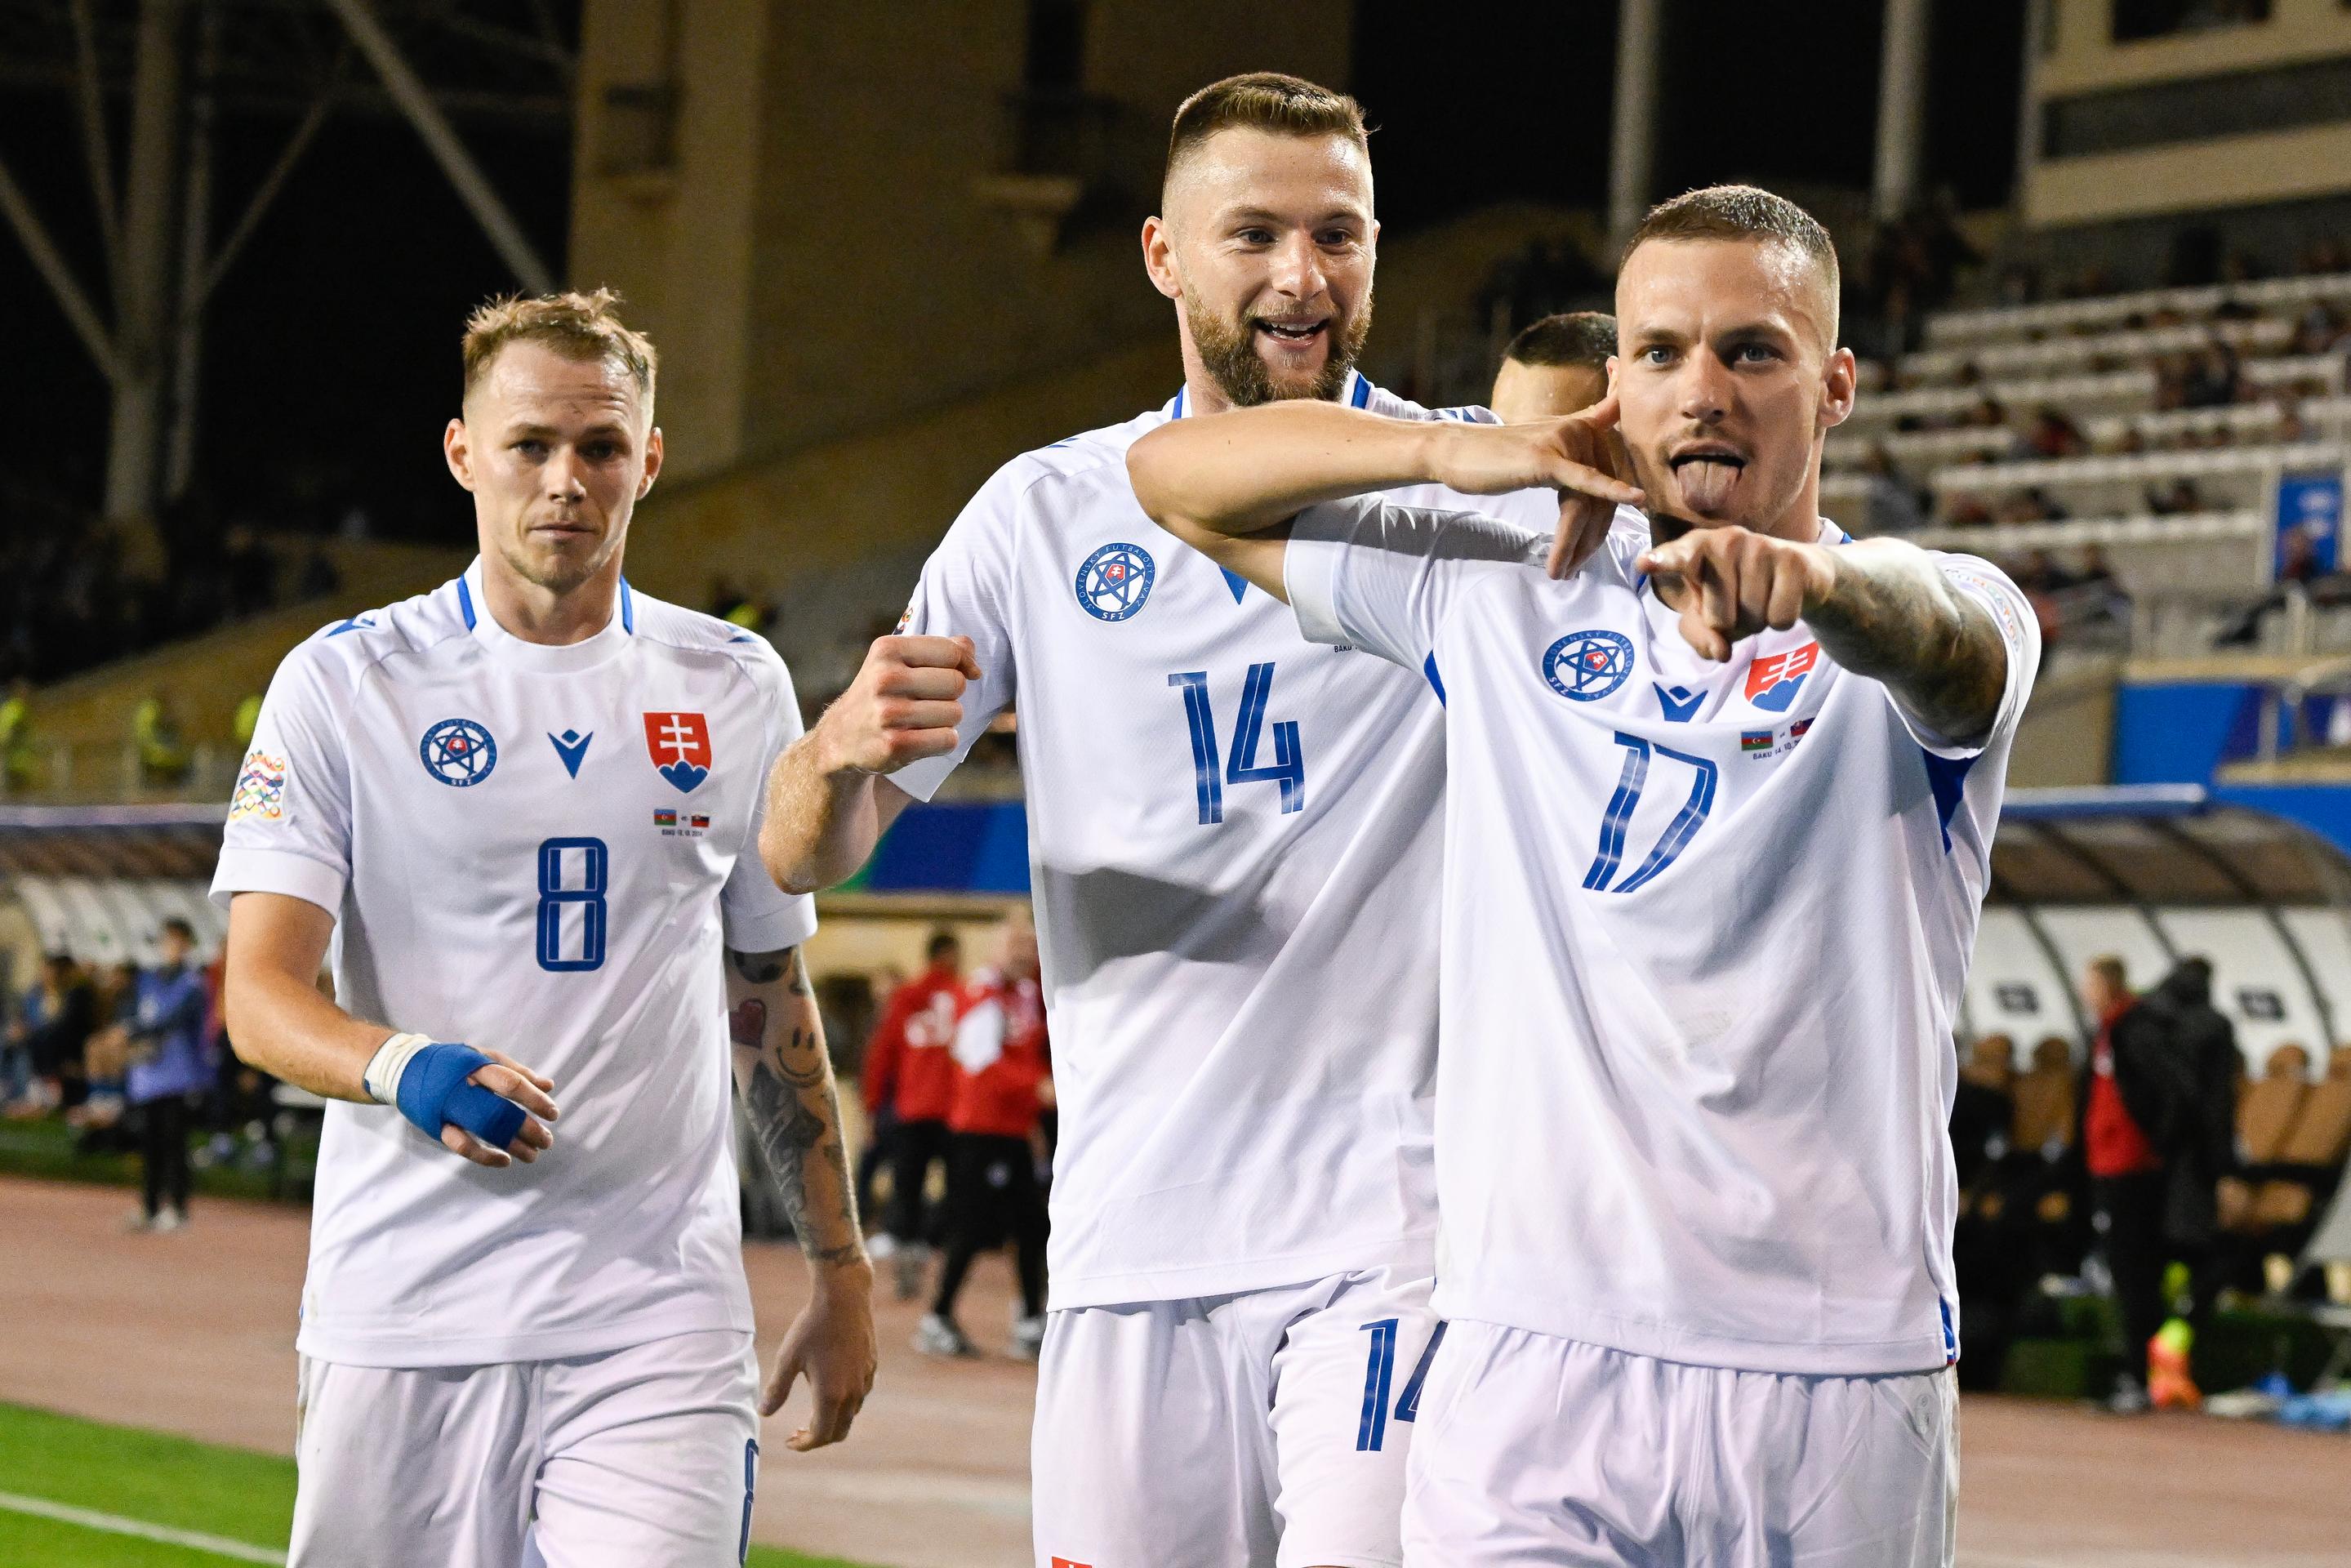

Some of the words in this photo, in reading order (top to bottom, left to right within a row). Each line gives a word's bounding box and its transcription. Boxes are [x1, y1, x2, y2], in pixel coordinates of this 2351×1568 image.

[1102, 612, 1124, 620] SFZ
[1168, 662, 1305, 826] 14
[1582, 730, 1718, 893] 17
[1752, 751, 1773, 760] BAKU
[537, 836, 608, 972] 8
